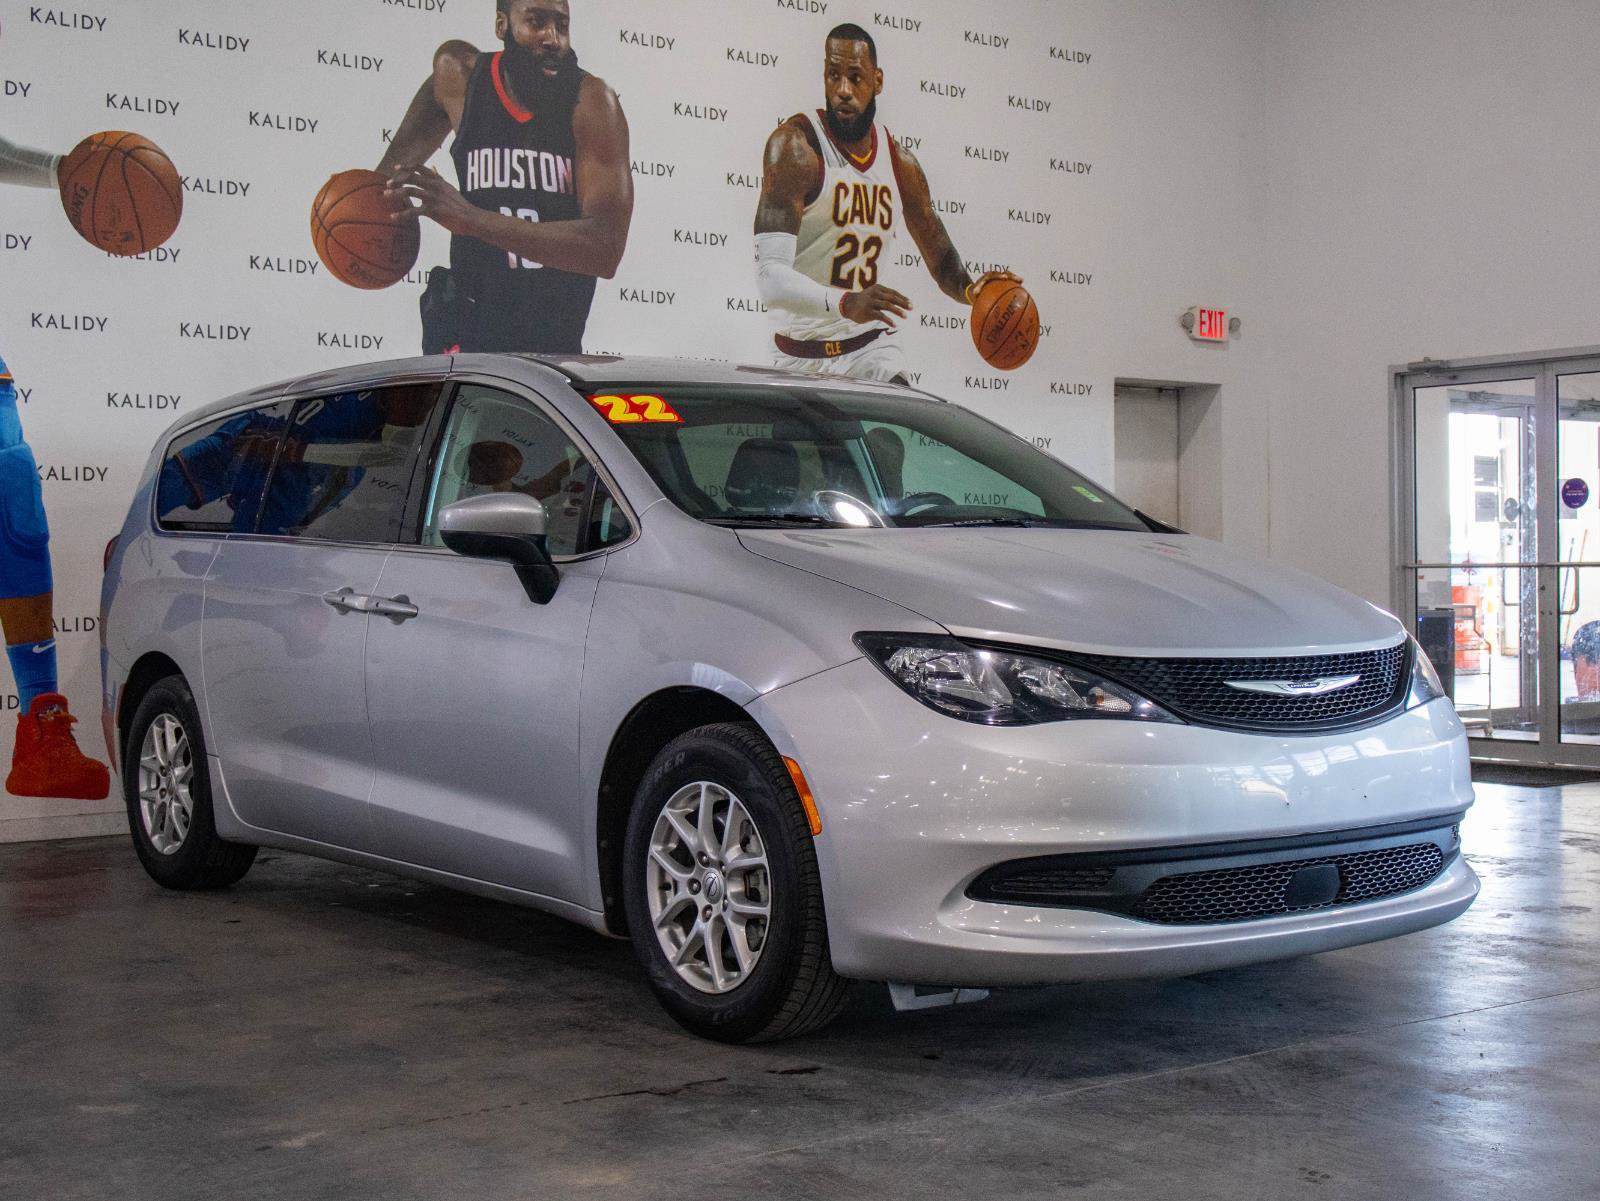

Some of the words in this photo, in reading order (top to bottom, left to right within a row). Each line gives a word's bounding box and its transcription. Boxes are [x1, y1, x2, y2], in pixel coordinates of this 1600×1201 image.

[382, 0, 446, 13] LIDY
[777, 0, 828, 14] KALIDY
[30, 7, 107, 32] KALIDY
[874, 12, 922, 33] KALIDY
[178, 28, 250, 53] KALIDY
[620, 29, 676, 51] KALIDY
[964, 30, 1009, 49] KALIDY
[317, 49, 384, 72] KALIDY
[726, 47, 779, 68] KALIDY
[1049, 46, 1092, 65] KALIDY
[920, 80, 966, 99] KALIDY
[106, 92, 181, 116] KALIDY
[673, 101, 728, 122] KALIDY
[1008, 95, 1052, 113] KALIDY
[249, 111, 319, 134] KALIDY
[893, 135, 922, 150] IDY
[964, 145, 1010, 163] KALIDY
[466, 147, 575, 195] HOUSTON
[631, 160, 675, 178] ALIDY
[1049, 158, 1092, 175] KALIDY
[180, 175, 251, 198] KALIDY
[726, 172, 758, 188] KALI
[832, 182, 893, 230] CAVS
[930, 199, 966, 215] ALIDY
[1008, 208, 1052, 225] KALIDY
[673, 229, 728, 247] KALIDY
[107, 247, 181, 263] LIDY
[830, 233, 882, 290] 23
[893, 254, 922, 268] IDY
[249, 255, 319, 275] KALIDY
[1050, 272, 1093, 287] KALIDY
[620, 287, 676, 305] KALIDY
[727, 297, 768, 313] KALI
[31, 312, 108, 332] KALIDY
[920, 314, 967, 330] KALIDY
[1199, 309, 1225, 338] EXIT
[180, 322, 251, 341] KALIDY
[317, 331, 384, 350] KALIDY
[825, 342, 842, 357] CLE
[965, 375, 1010, 391] KALIDY
[1050, 381, 1093, 397] KALIDY
[107, 392, 181, 410] KALIDY
[592, 395, 679, 422] 22
[726, 424, 768, 438] KALI
[1030, 437, 1052, 449] IDY
[963, 493, 1009, 506] KALIDY
